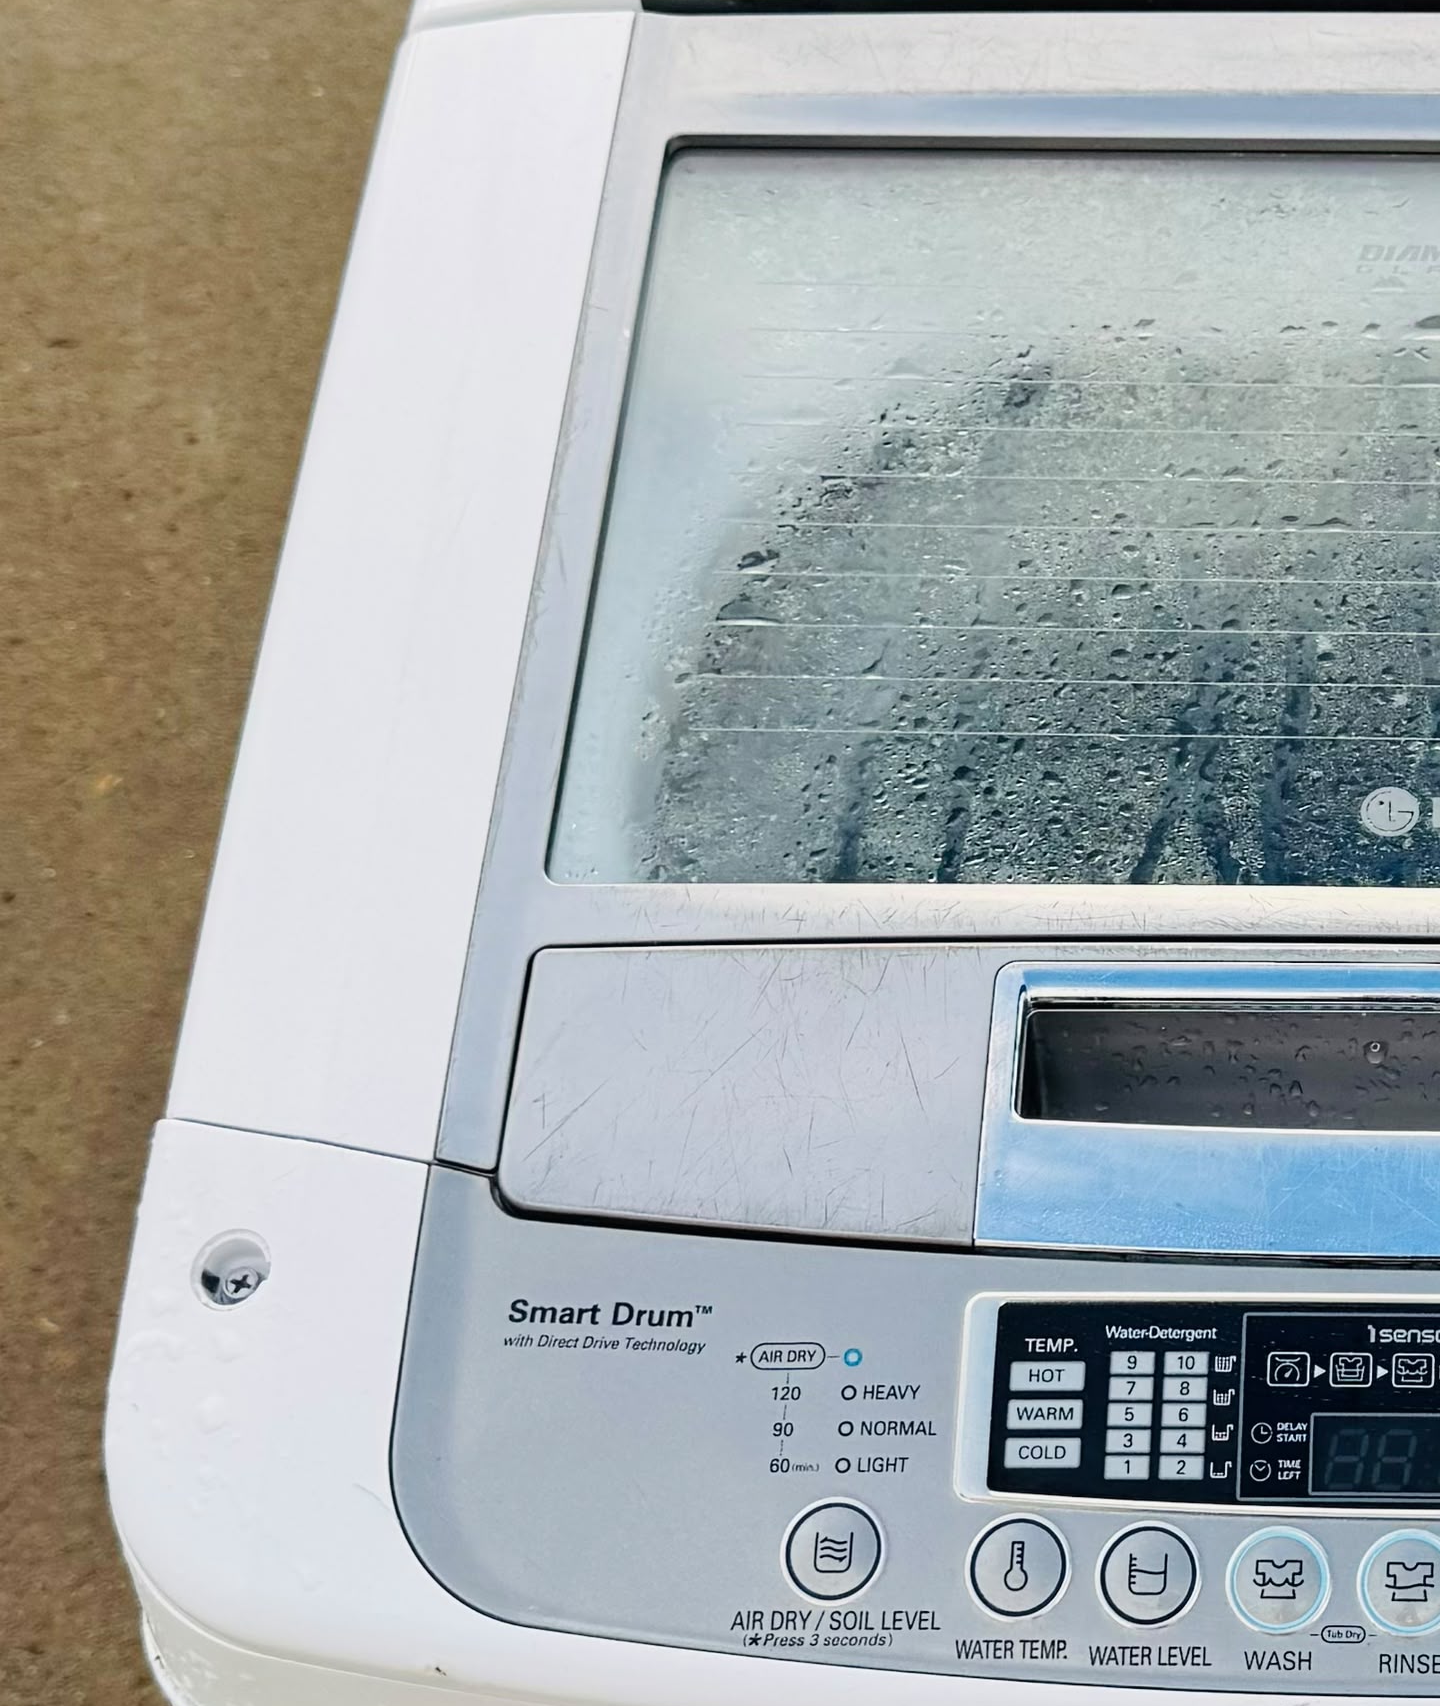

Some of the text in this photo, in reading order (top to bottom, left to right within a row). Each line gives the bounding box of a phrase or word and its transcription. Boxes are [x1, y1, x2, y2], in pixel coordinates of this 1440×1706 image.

[508, 1298, 602, 1325] Smart
[503, 1333, 707, 1356] with Direct Drive Technology
[1025, 1337, 1079, 1353] TEMP.
[758, 1349, 816, 1363] AIR DRY
[1127, 1355, 1195, 1370] 9 10
[1028, 1368, 1066, 1383] HOT
[771, 1386, 801, 1401] 120
[862, 1384, 921, 1400] HEAVY
[1126, 1381, 1190, 1396] 7 8
[1016, 1406, 1075, 1421] WARM
[1124, 1407, 1189, 1422] 5 6
[772, 1422, 794, 1437] 90
[860, 1421, 937, 1437] NORMAL
[1276, 1422, 1308, 1431] DELAY
[1123, 1433, 1187, 1448] 3 4
[1276, 1433, 1307, 1442] START
[1018, 1445, 1067, 1461] COLD
[857, 1457, 909, 1473] LIGHT
[1124, 1460, 1186, 1475] 1 2
[1278, 1459, 1301, 1469] TIME
[1278, 1470, 1301, 1480] LEFT
[730, 1611, 767, 1631] AIR
[770, 1611, 812, 1631] DRY
[830, 1611, 877, 1631] SOIL
[881, 1611, 941, 1632] LEVEL
[809, 1634, 820, 1648] 3
[823, 1633, 894, 1649] seconds)
[1326, 1630, 1363, 1641] Tub Dry
[955, 1639, 1068, 1661] WATER TEMP.
[1088, 1646, 1213, 1667] WATER LEVEL
[1243, 1650, 1313, 1671] WASH
